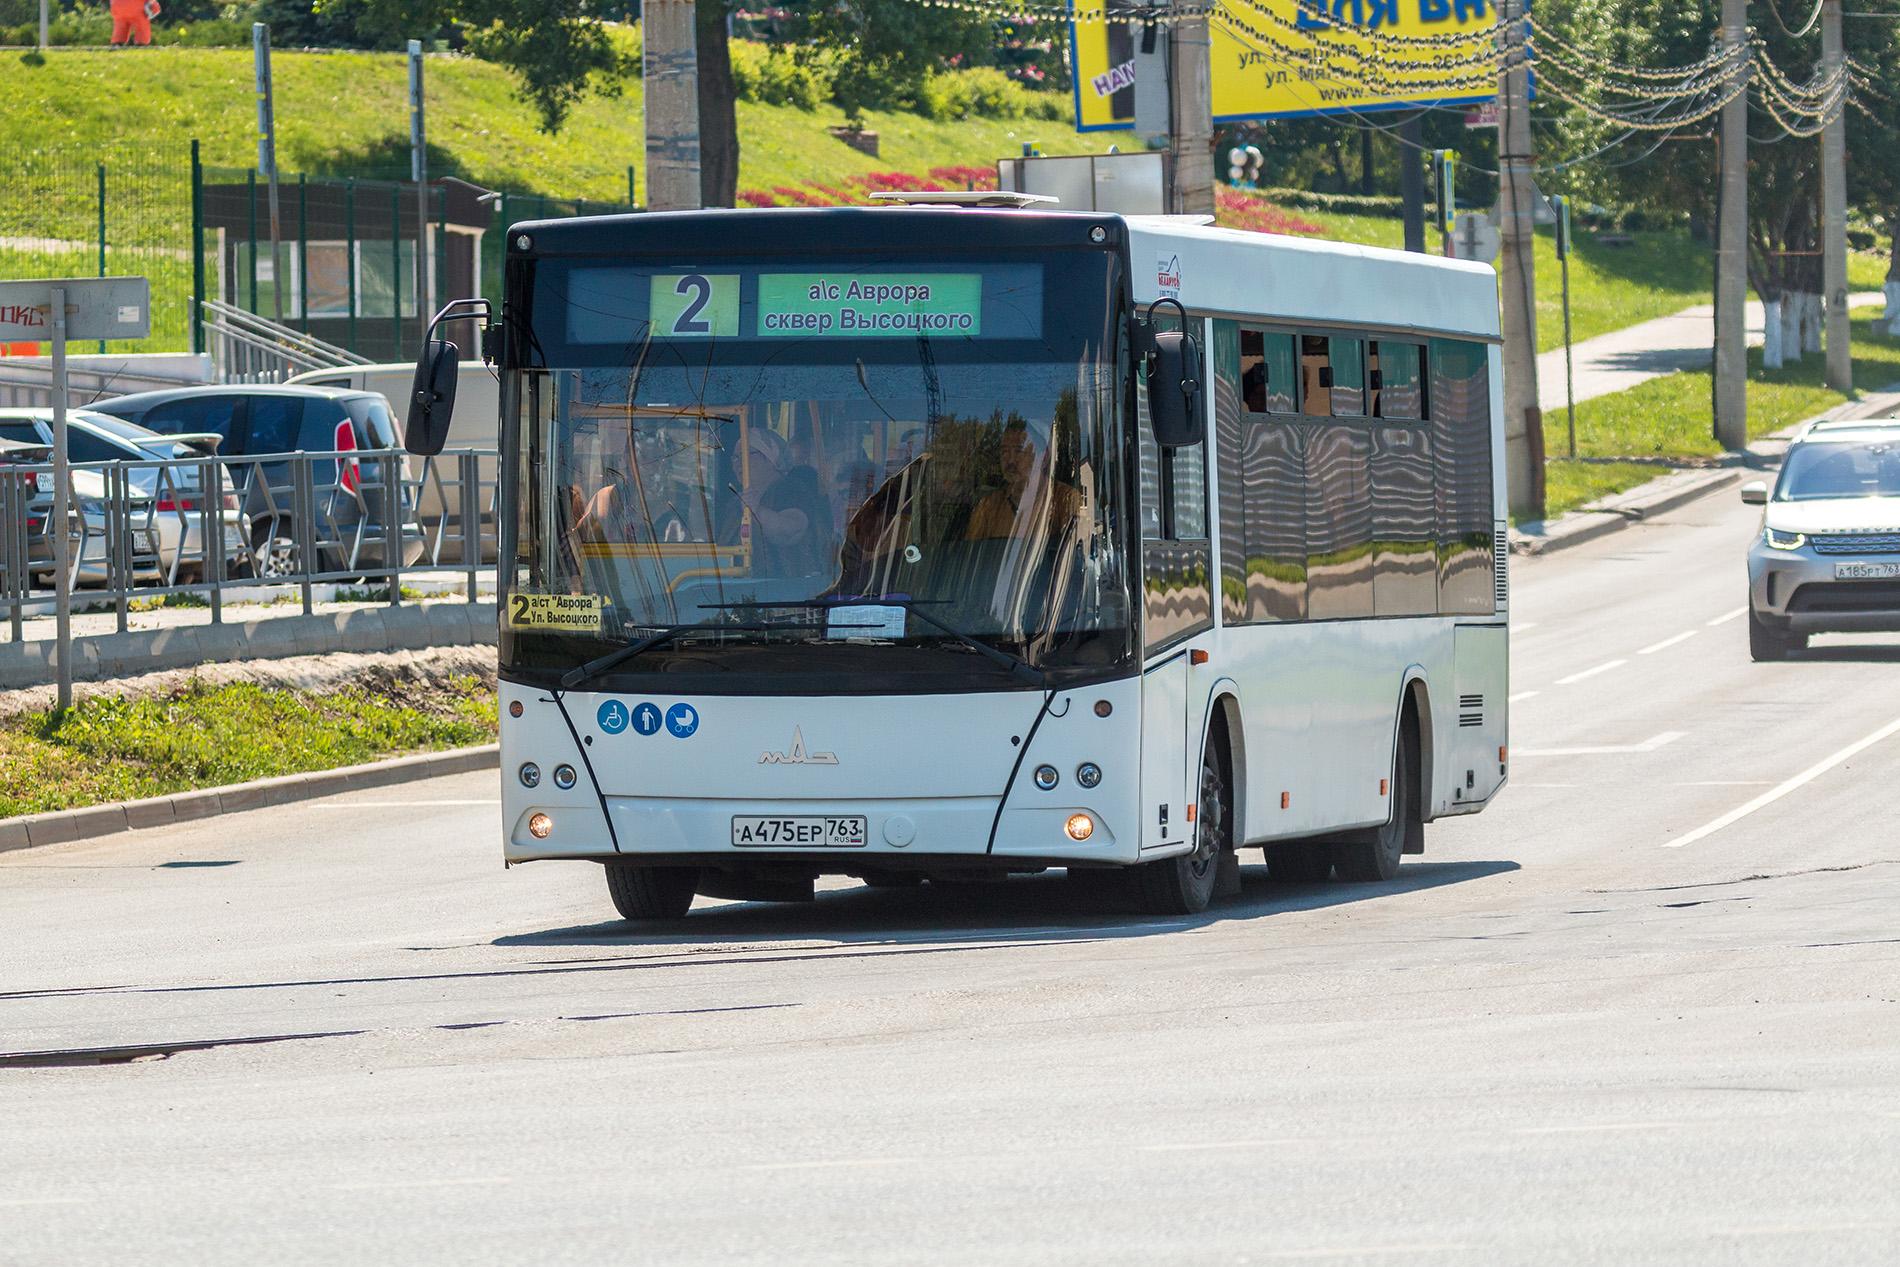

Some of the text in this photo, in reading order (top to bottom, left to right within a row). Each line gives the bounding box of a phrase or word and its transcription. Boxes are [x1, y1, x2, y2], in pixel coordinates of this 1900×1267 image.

[1265, 71, 1293, 89] ул.
[846, 280, 930, 305] Аврора
[673, 275, 711, 333] 2
[765, 308, 973, 334] сквер Высоцкого
[512, 595, 531, 624] 2
[552, 595, 598, 611] "Аврора"
[547, 611, 599, 626] Высоцкого
[827, 820, 859, 836] 763
